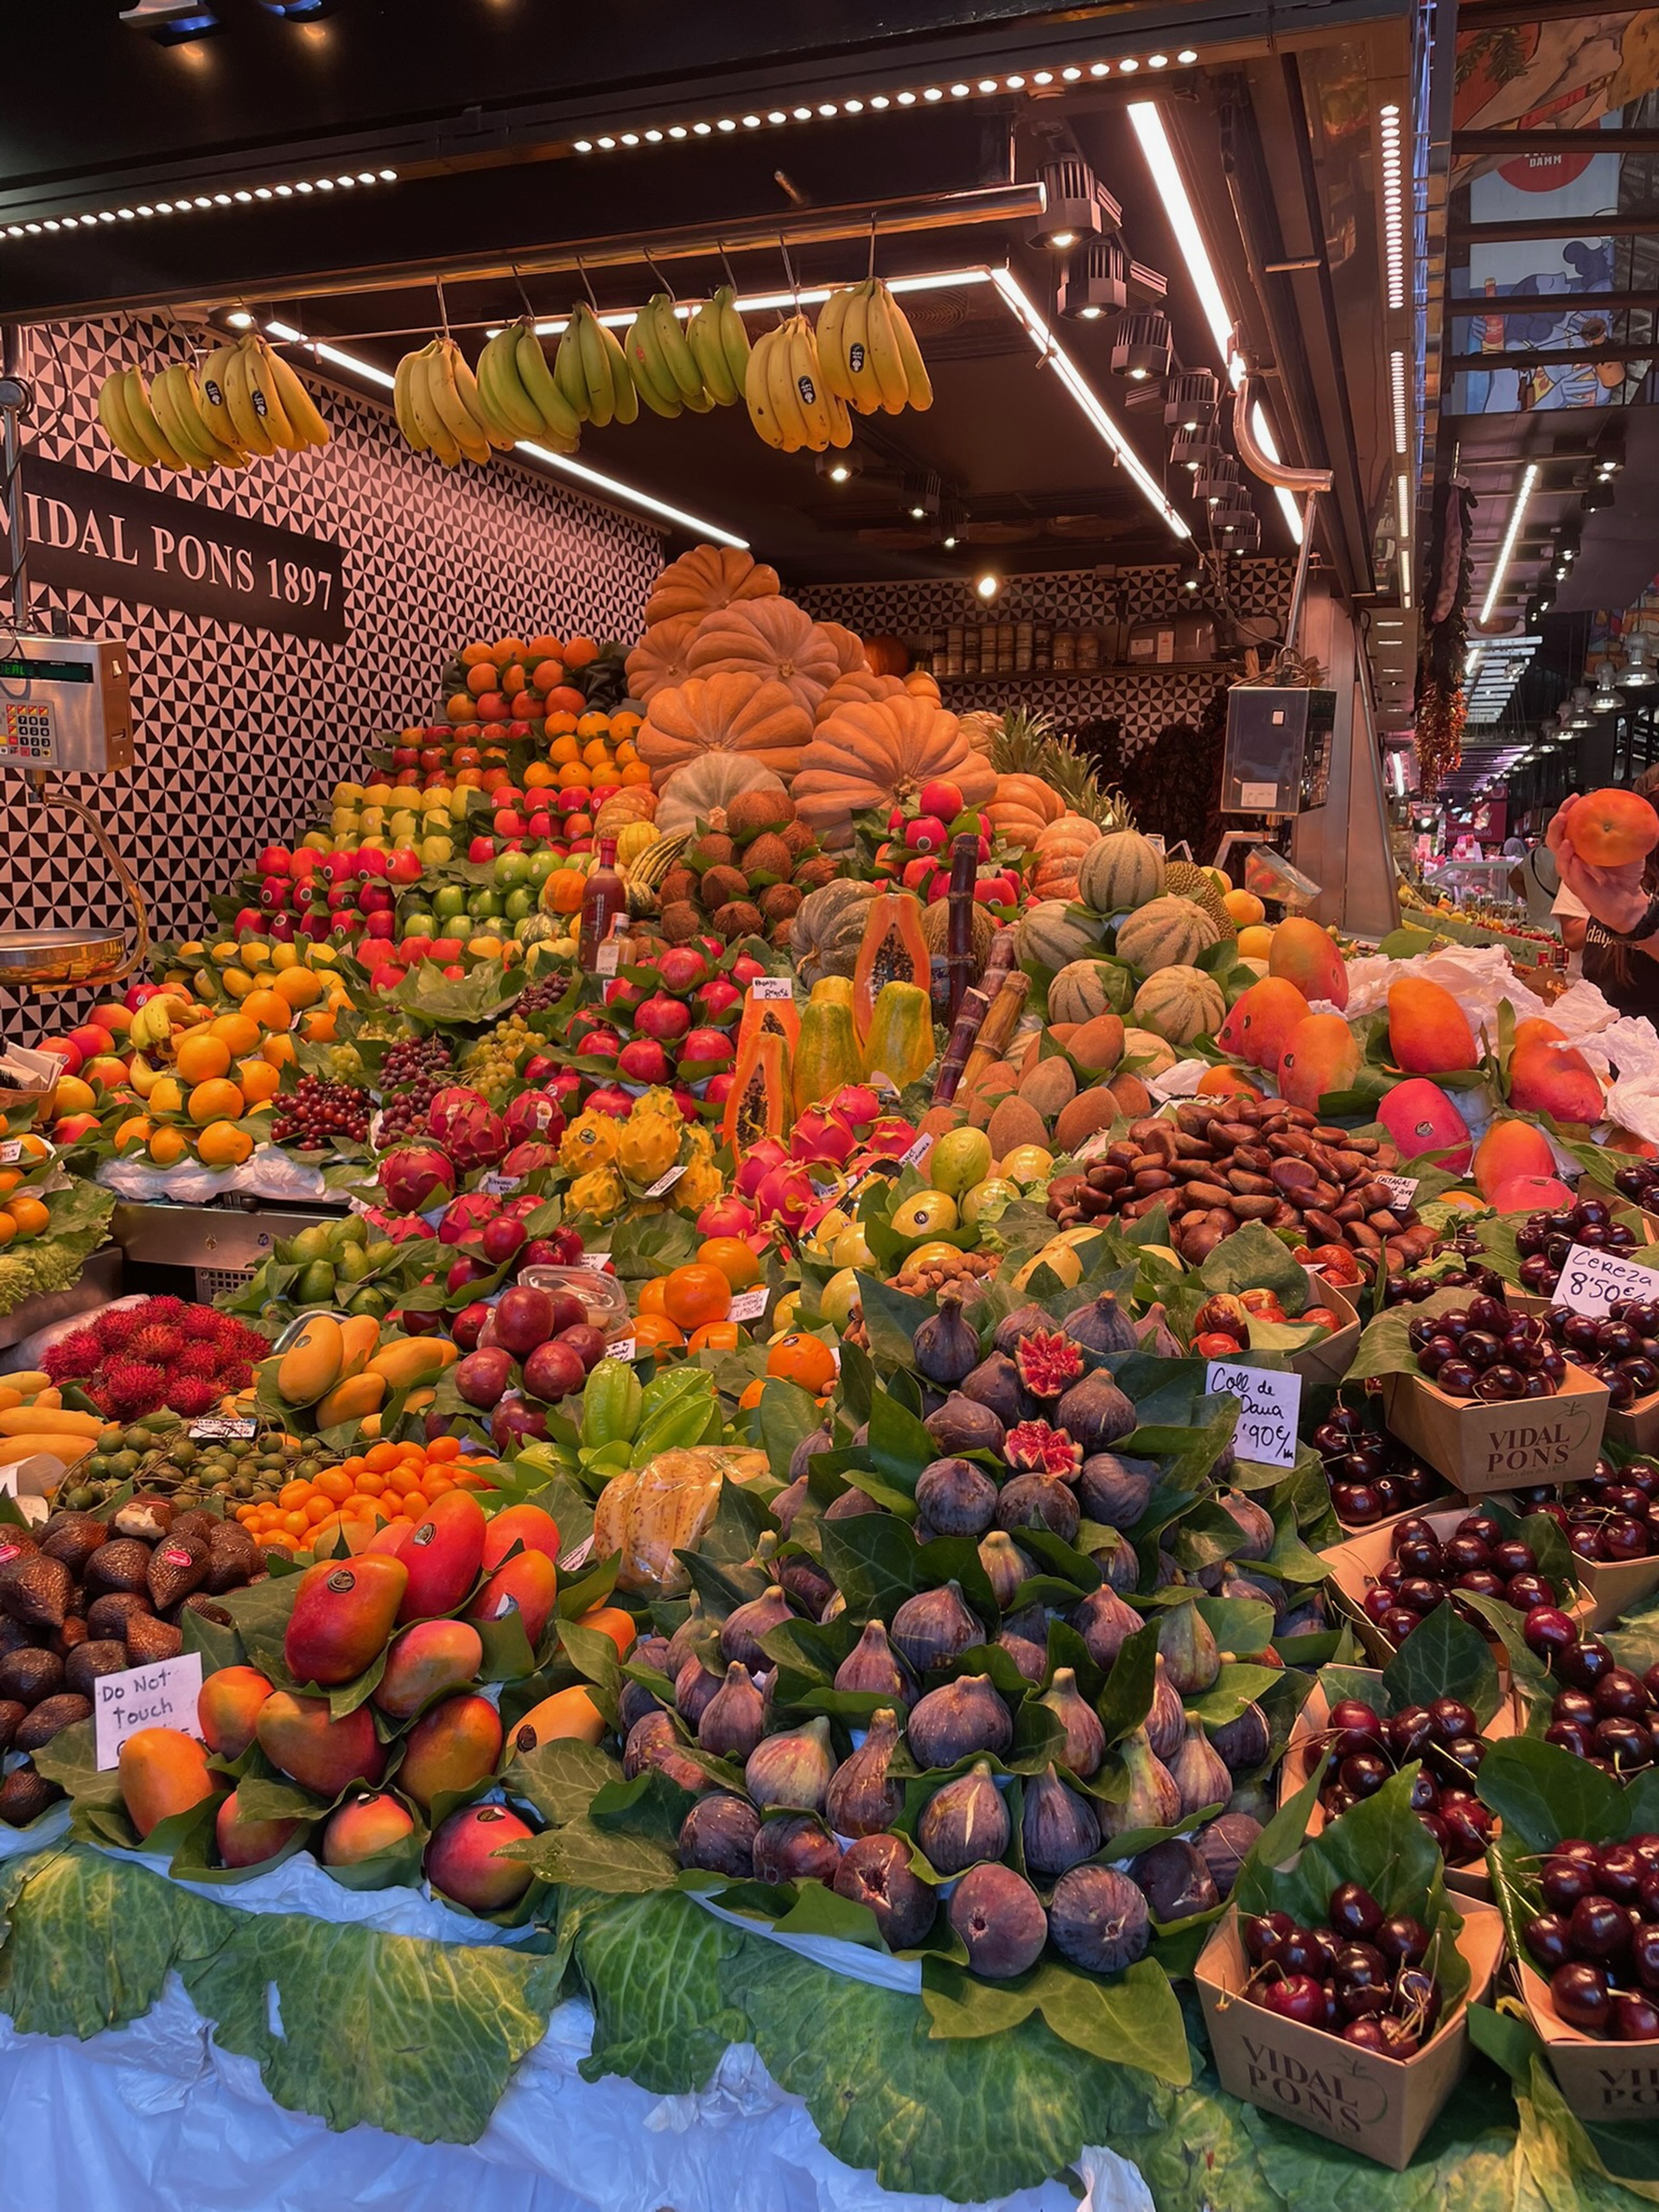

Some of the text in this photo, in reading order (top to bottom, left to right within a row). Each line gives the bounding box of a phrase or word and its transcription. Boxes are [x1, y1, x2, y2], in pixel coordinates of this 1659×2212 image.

[1529, 155, 1562, 168] DAMM
[151, 525, 255, 594] PONS
[266, 558, 332, 611] 1897
[1211, 1367, 1275, 1396] Coll de
[1489, 1423, 1571, 1452] VIDAL
[1487, 1444, 1569, 1472] PONS
[1241, 2033, 1358, 2108] VIDAL
[1247, 2062, 1362, 2133] PONS
